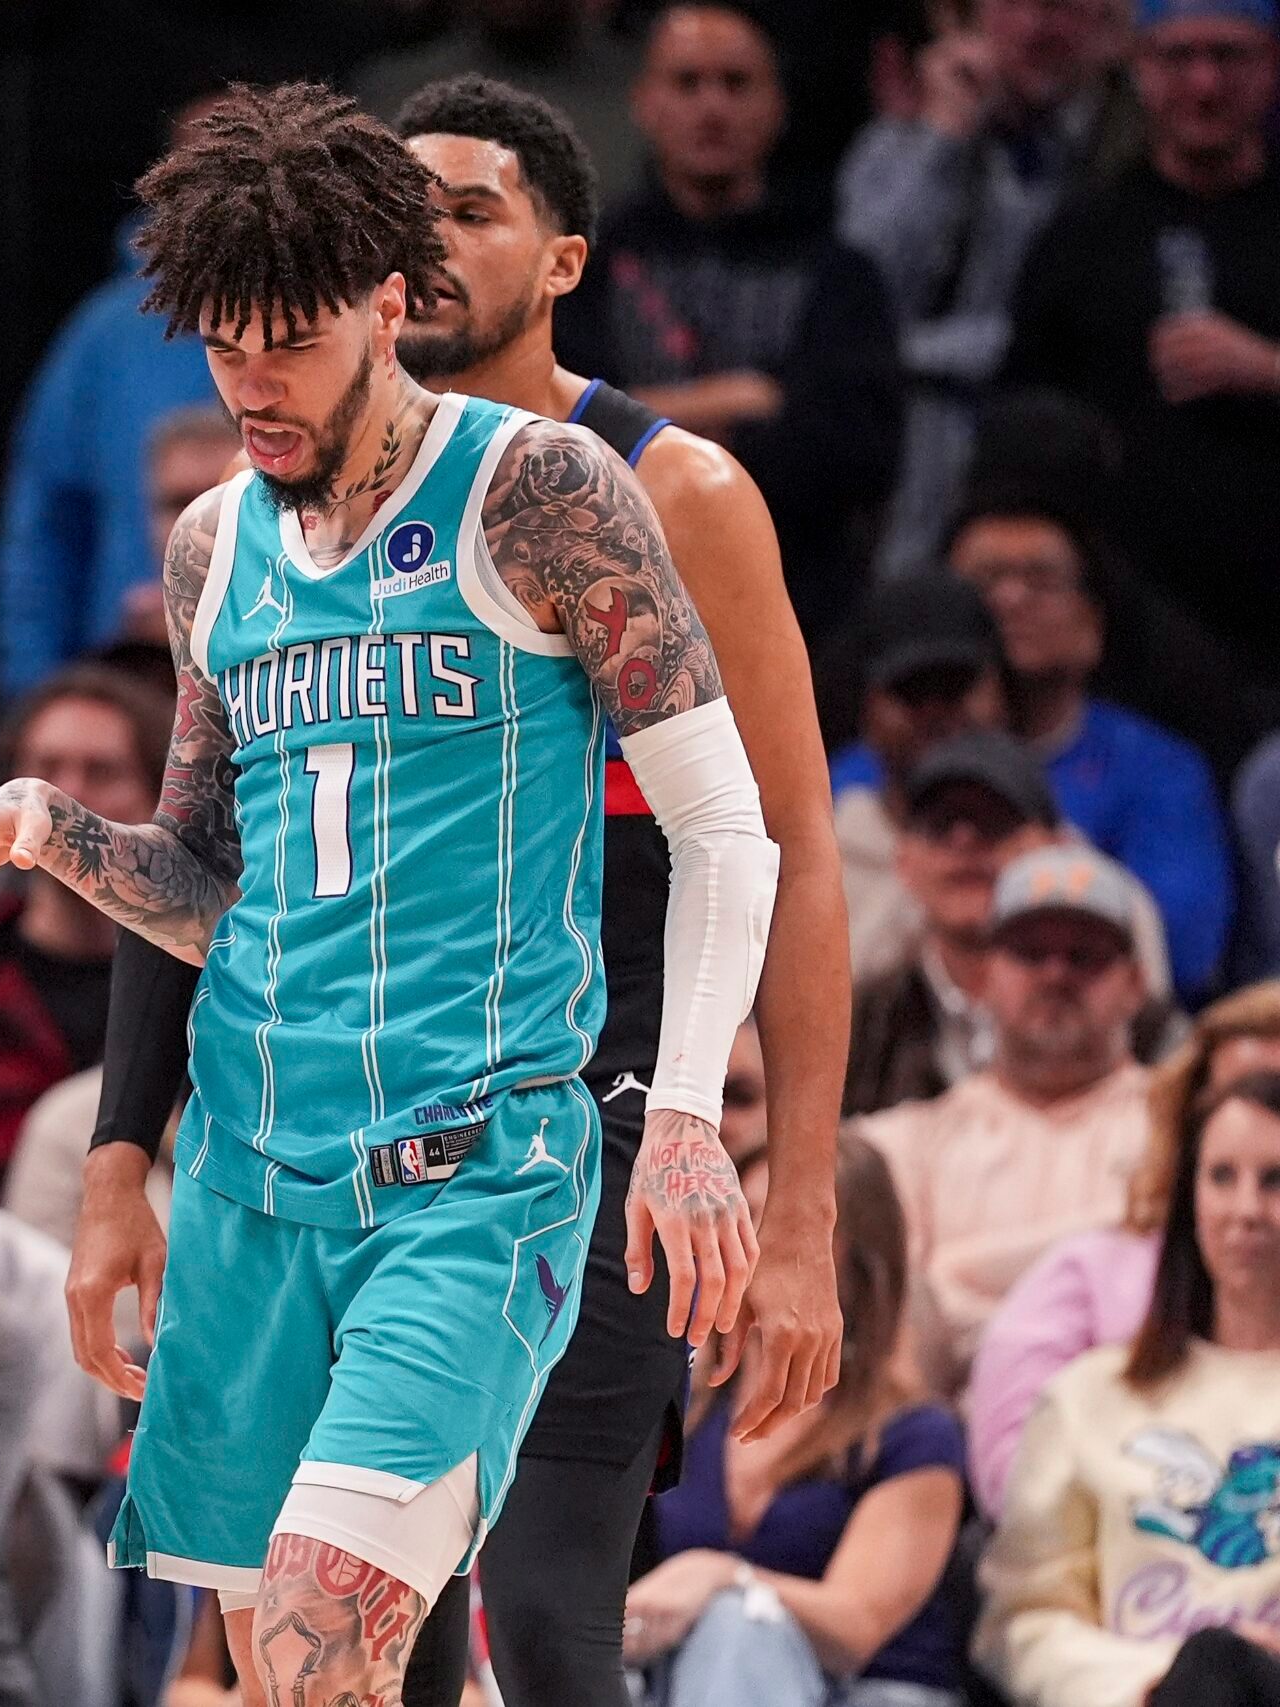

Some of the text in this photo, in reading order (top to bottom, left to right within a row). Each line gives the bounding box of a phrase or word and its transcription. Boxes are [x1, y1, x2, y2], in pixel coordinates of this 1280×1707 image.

[373, 564, 448, 597] Judi Health
[223, 632, 485, 749] HORNETS
[303, 741, 355, 899] 1
[428, 1147, 441, 1157] 44
[650, 1141, 683, 1170] NOT
[665, 1170, 733, 1200] HERE
